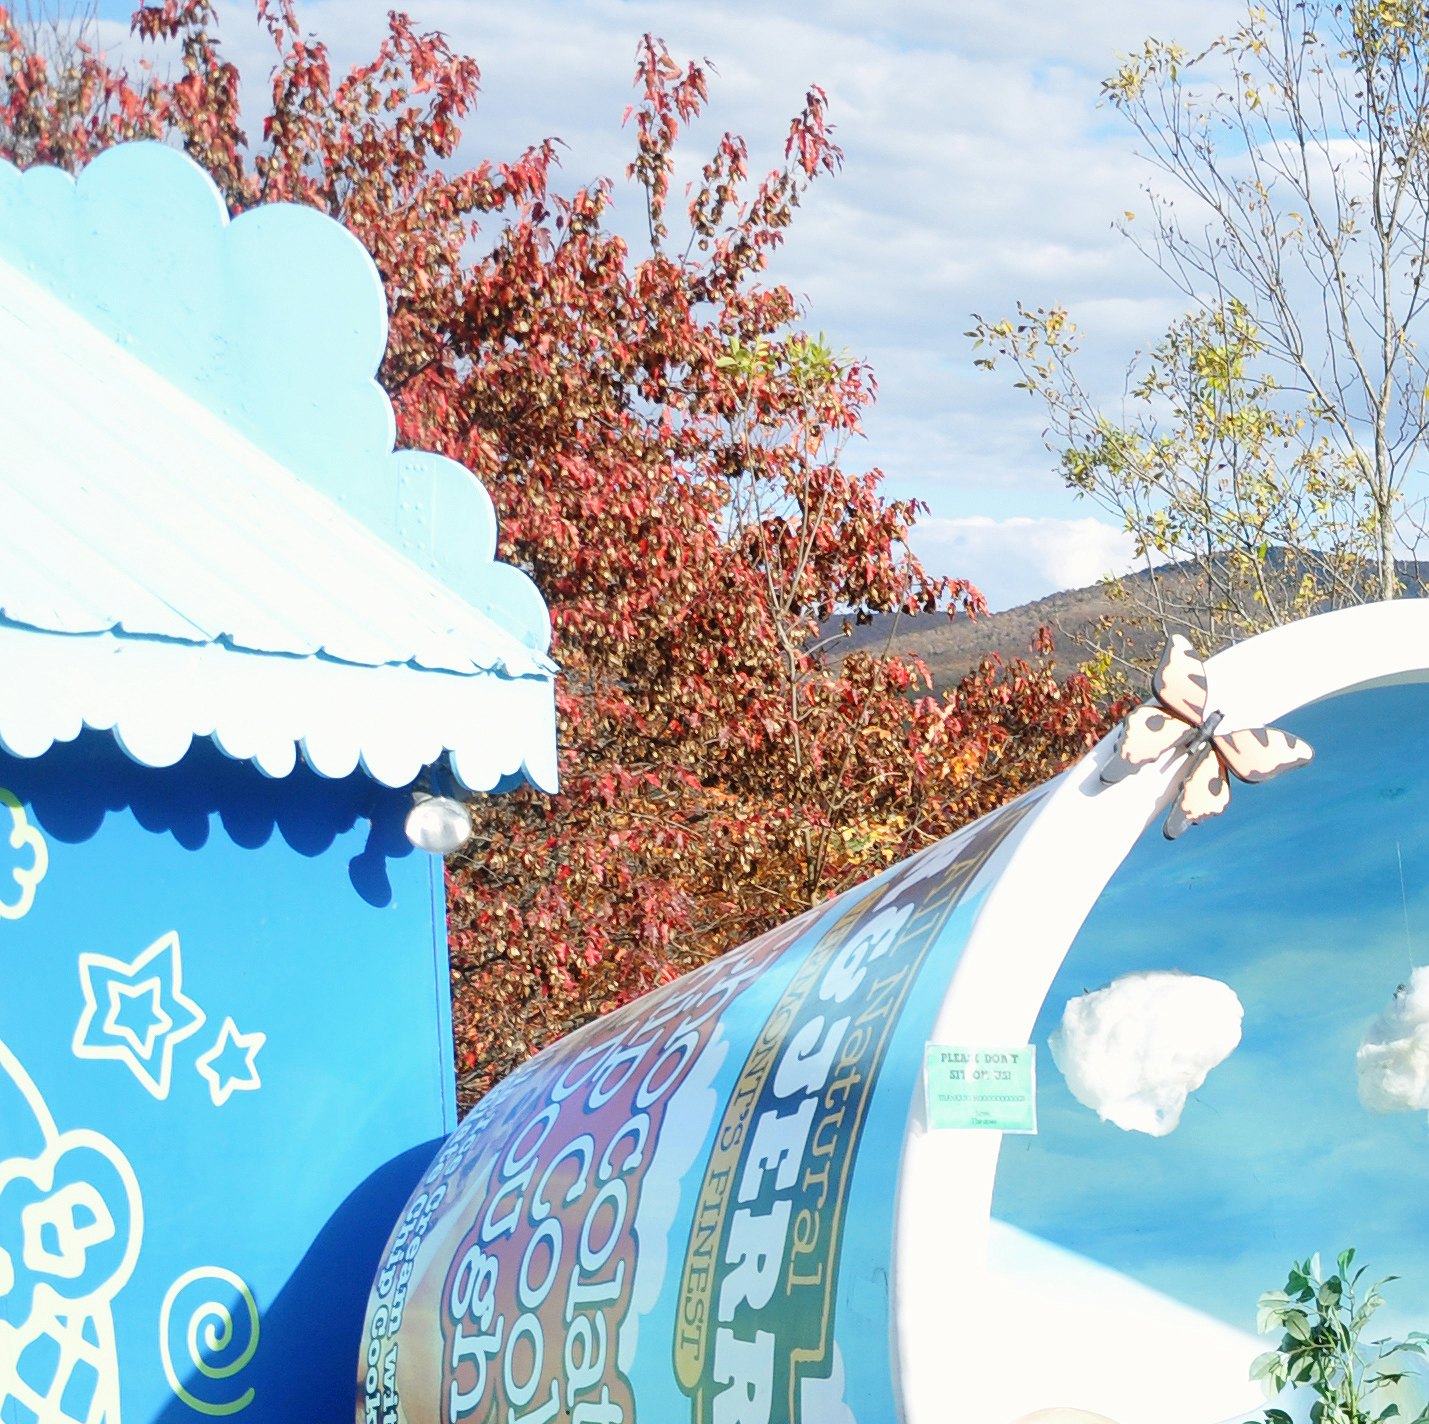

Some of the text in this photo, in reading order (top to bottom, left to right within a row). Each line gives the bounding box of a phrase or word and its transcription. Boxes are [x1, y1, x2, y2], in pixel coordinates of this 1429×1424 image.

[589, 948, 756, 1109] hip
[819, 902, 915, 1003] &
[786, 964, 910, 1296] Natural
[376, 1194, 429, 1299] Chip
[387, 1184, 448, 1339] Cream
[450, 1021, 640, 1424] Dough
[681, 1166, 731, 1361] FINEST
